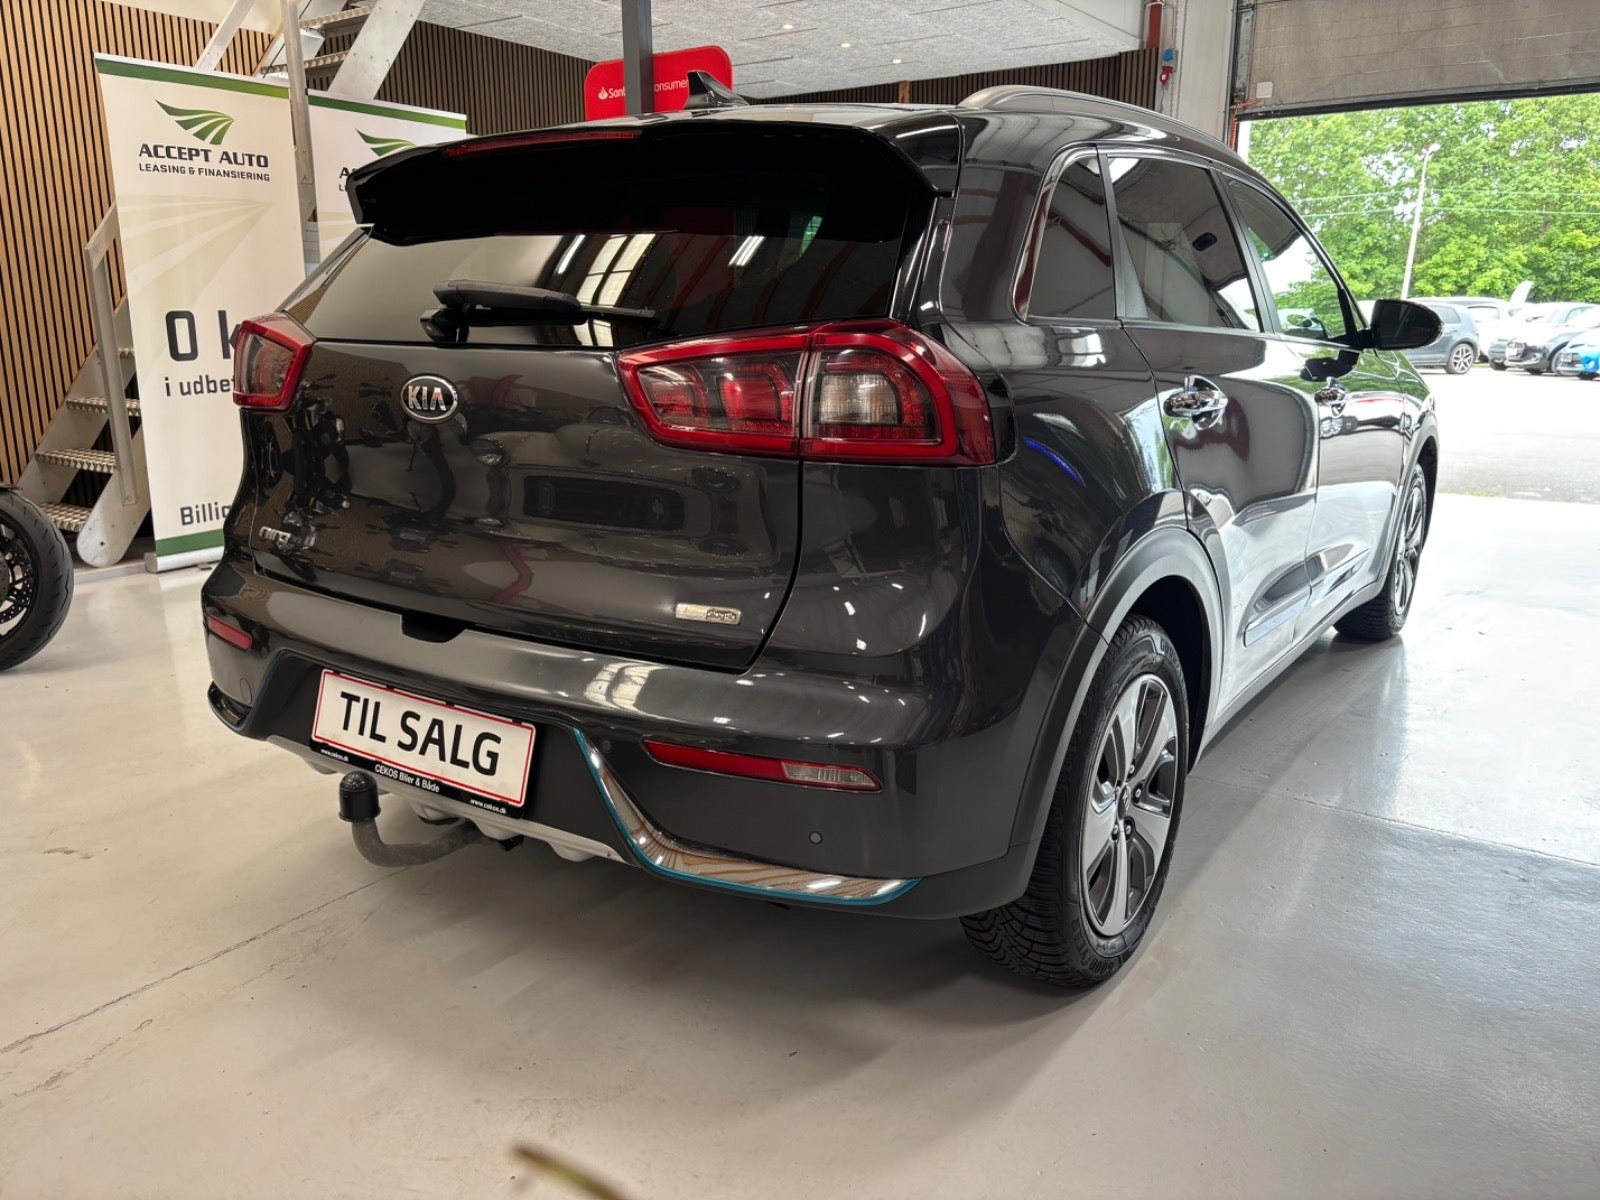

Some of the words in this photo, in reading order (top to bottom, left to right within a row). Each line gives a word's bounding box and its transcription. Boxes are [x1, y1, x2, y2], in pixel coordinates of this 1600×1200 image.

[138, 143, 212, 162] ACCEPT
[219, 150, 270, 168] AUTO
[138, 162, 187, 175] LEASING
[188, 166, 196, 176] &
[197, 167, 271, 182] FINANSIERING
[164, 376, 171, 397] i
[179, 374, 236, 396] udbe
[408, 384, 447, 411] KIA
[340, 691, 387, 743] TIL
[397, 710, 502, 777] SALG
[374, 763, 399, 780] CEKOS
[415, 777, 421, 787] &
